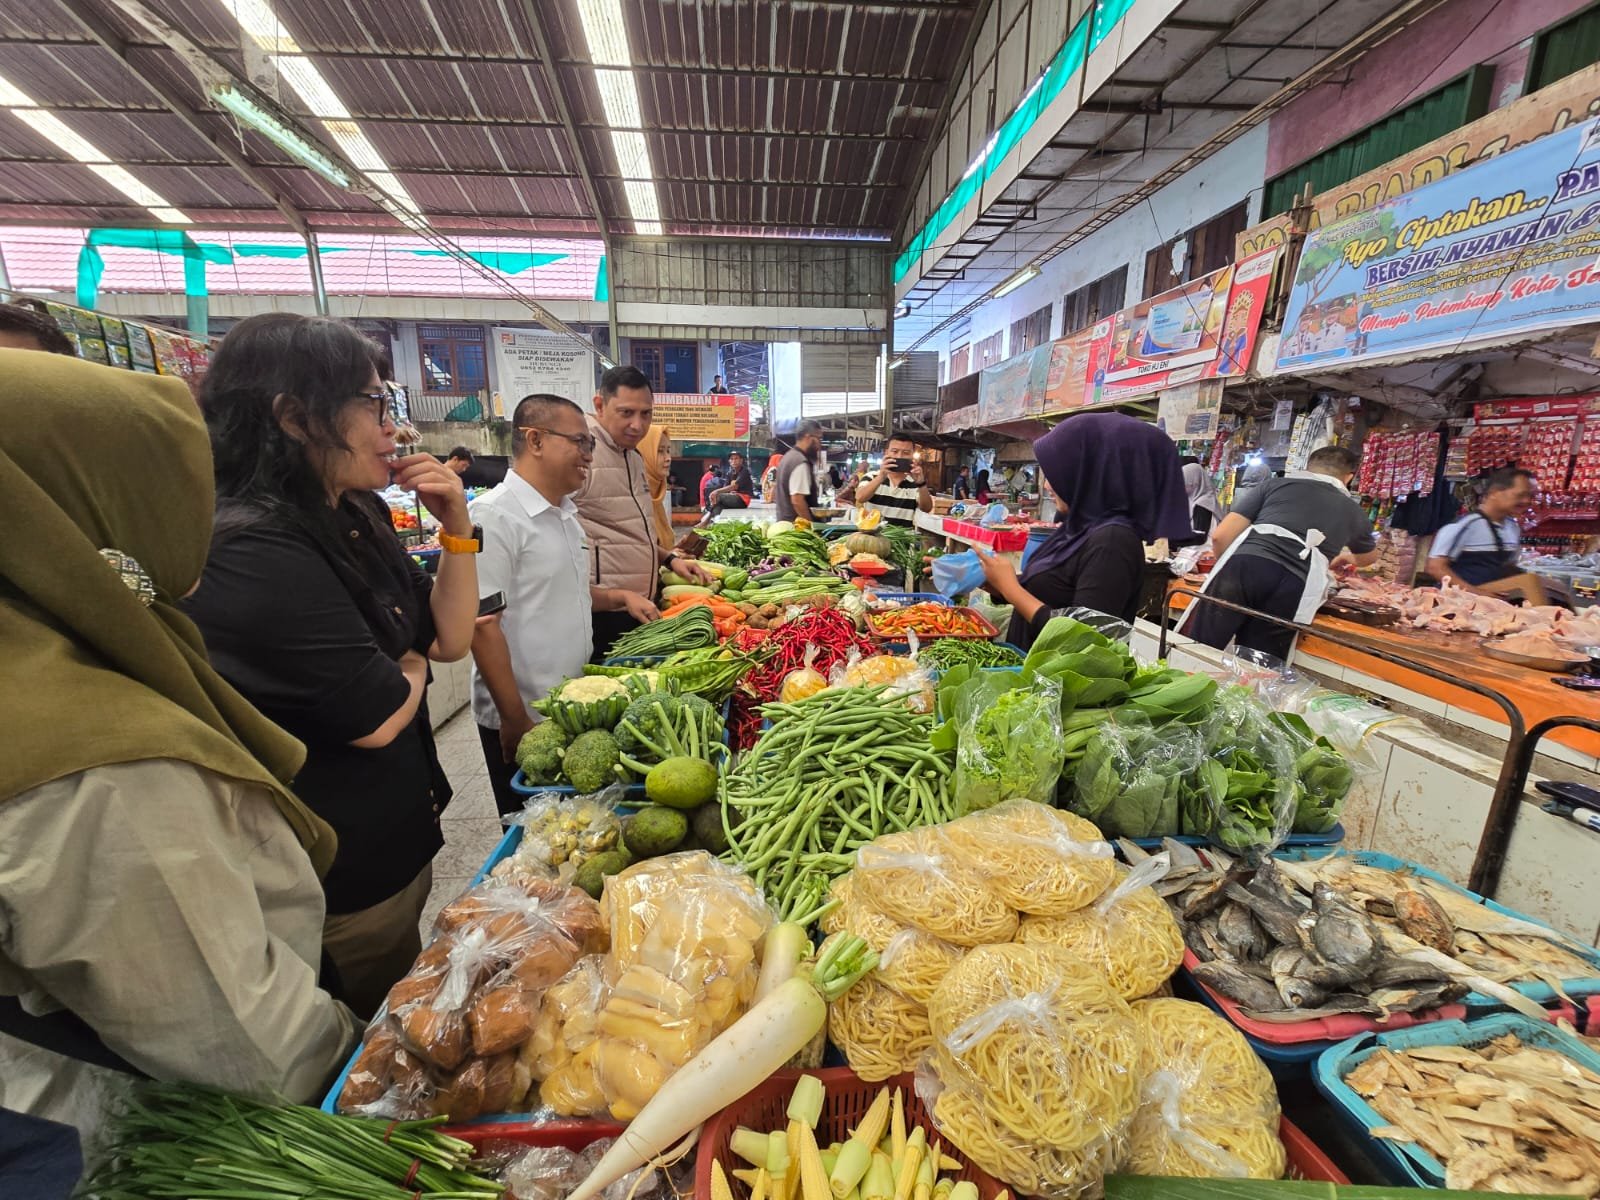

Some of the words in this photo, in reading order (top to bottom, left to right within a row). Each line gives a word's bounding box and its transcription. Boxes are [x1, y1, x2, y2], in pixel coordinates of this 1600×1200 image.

[1340, 236, 1388, 269] Ayo
[1364, 246, 1444, 289] BERSIH,
[1441, 210, 1573, 265] NYAMAN
[1410, 275, 1437, 290] Pangan
[1439, 267, 1462, 280] Sehat
[1440, 280, 1457, 292] UKK
[1467, 264, 1518, 284] Penerapan
[1519, 250, 1573, 270] Kawasan
[1359, 312, 1411, 333] Menuju
[1415, 291, 1506, 322] Palembang
[1509, 274, 1561, 301] Kota
[653, 395, 712, 405] HIMBAUAN
